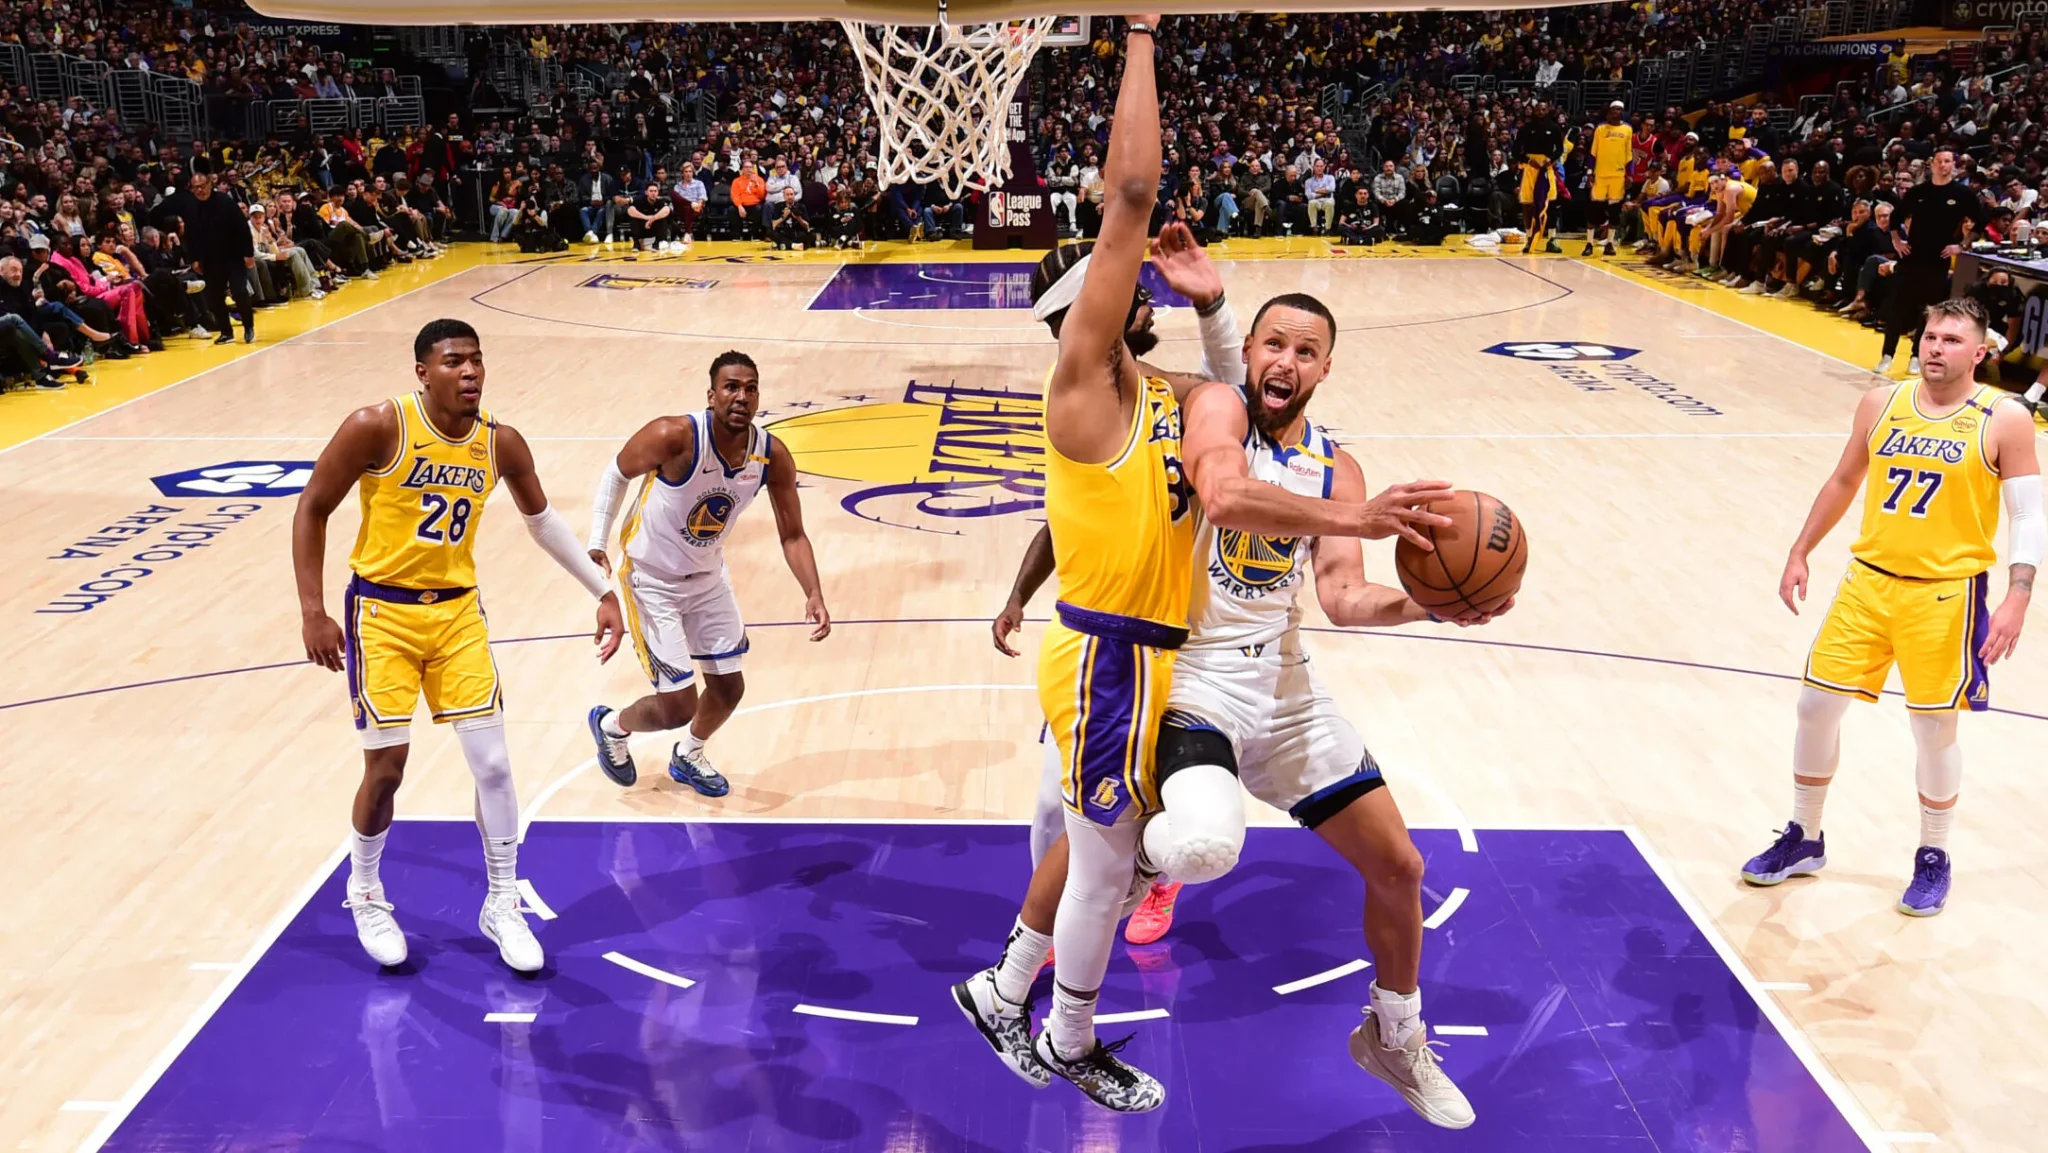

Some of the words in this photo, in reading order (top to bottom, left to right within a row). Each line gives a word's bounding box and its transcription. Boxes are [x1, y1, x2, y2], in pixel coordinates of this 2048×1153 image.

[1803, 43, 1877, 55] CHAMPIONS
[1008, 102, 1023, 114] GET
[1008, 114, 1023, 127] THE
[1006, 192, 1042, 212] League
[1006, 210, 1031, 227] Pass
[1541, 364, 1617, 392] ARENA
[1599, 363, 1724, 416] crypto.com
[1875, 427, 1967, 464] LAKERS
[399, 455, 487, 493] LAKERS
[1881, 466, 1944, 518] 77
[46, 503, 185, 560] ARENA
[416, 492, 472, 545] 28
[34, 503, 262, 613] crypto.com
[1208, 560, 1296, 599] WARRIORS
